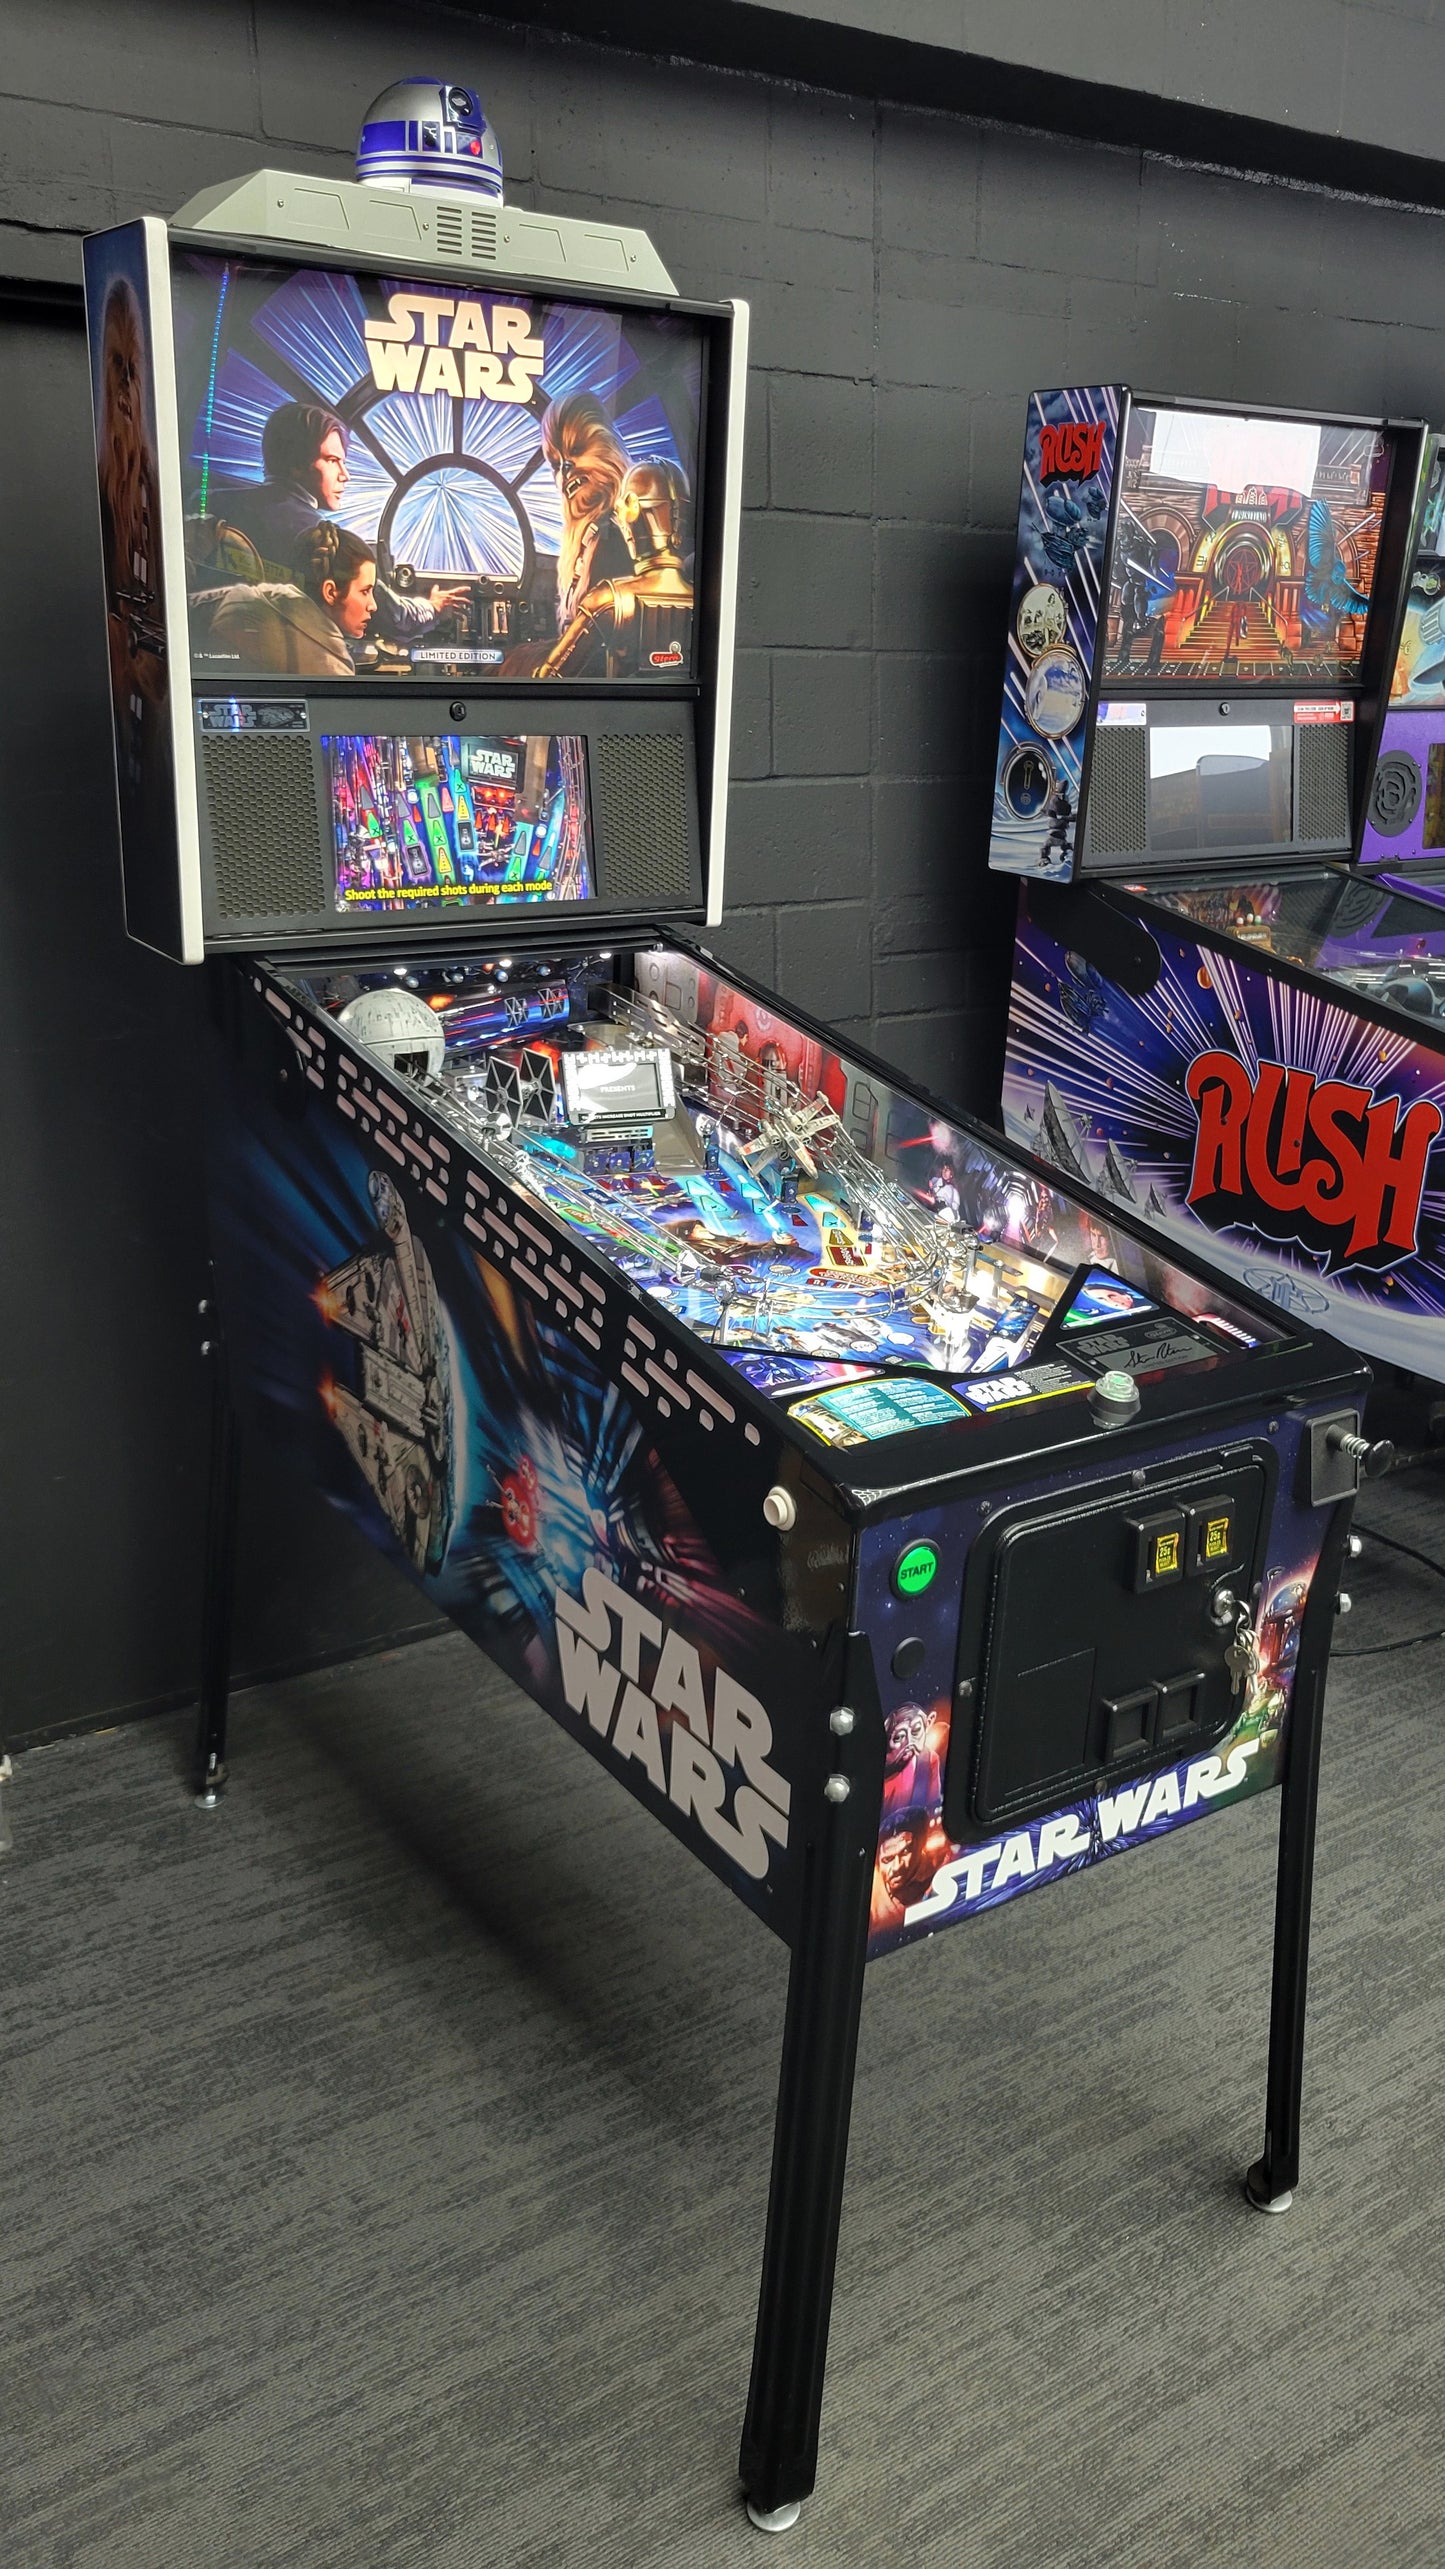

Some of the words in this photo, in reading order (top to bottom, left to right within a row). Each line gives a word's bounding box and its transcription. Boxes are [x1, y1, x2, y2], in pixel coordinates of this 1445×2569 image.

[365, 294, 544, 358] STAR
[365, 340, 544, 403] WARS
[1039, 420, 1106, 481] RUSH
[420, 651, 457, 660] LIMITED
[459, 652, 496, 660] EDITION
[470, 749, 516, 768] STAR
[471, 760, 516, 779] WARS
[345, 889, 376, 900] Shoot
[377, 888, 395, 899] the
[397, 885, 439, 899] required
[441, 884, 467, 896] shots
[469, 883, 500, 896] during
[501, 882, 523, 893] each
[525, 880, 552, 892] mode
[599, 1084, 636, 1093] PRESENTS
[1185, 1050, 1442, 1259] RUSH
[900, 1562, 934, 1580] START
[555, 1567, 791, 1815] STAR
[555, 1617, 789, 1880] WARS
[904, 1814, 1091, 1926] STAR
[1098, 1738, 1259, 1842] WARS
